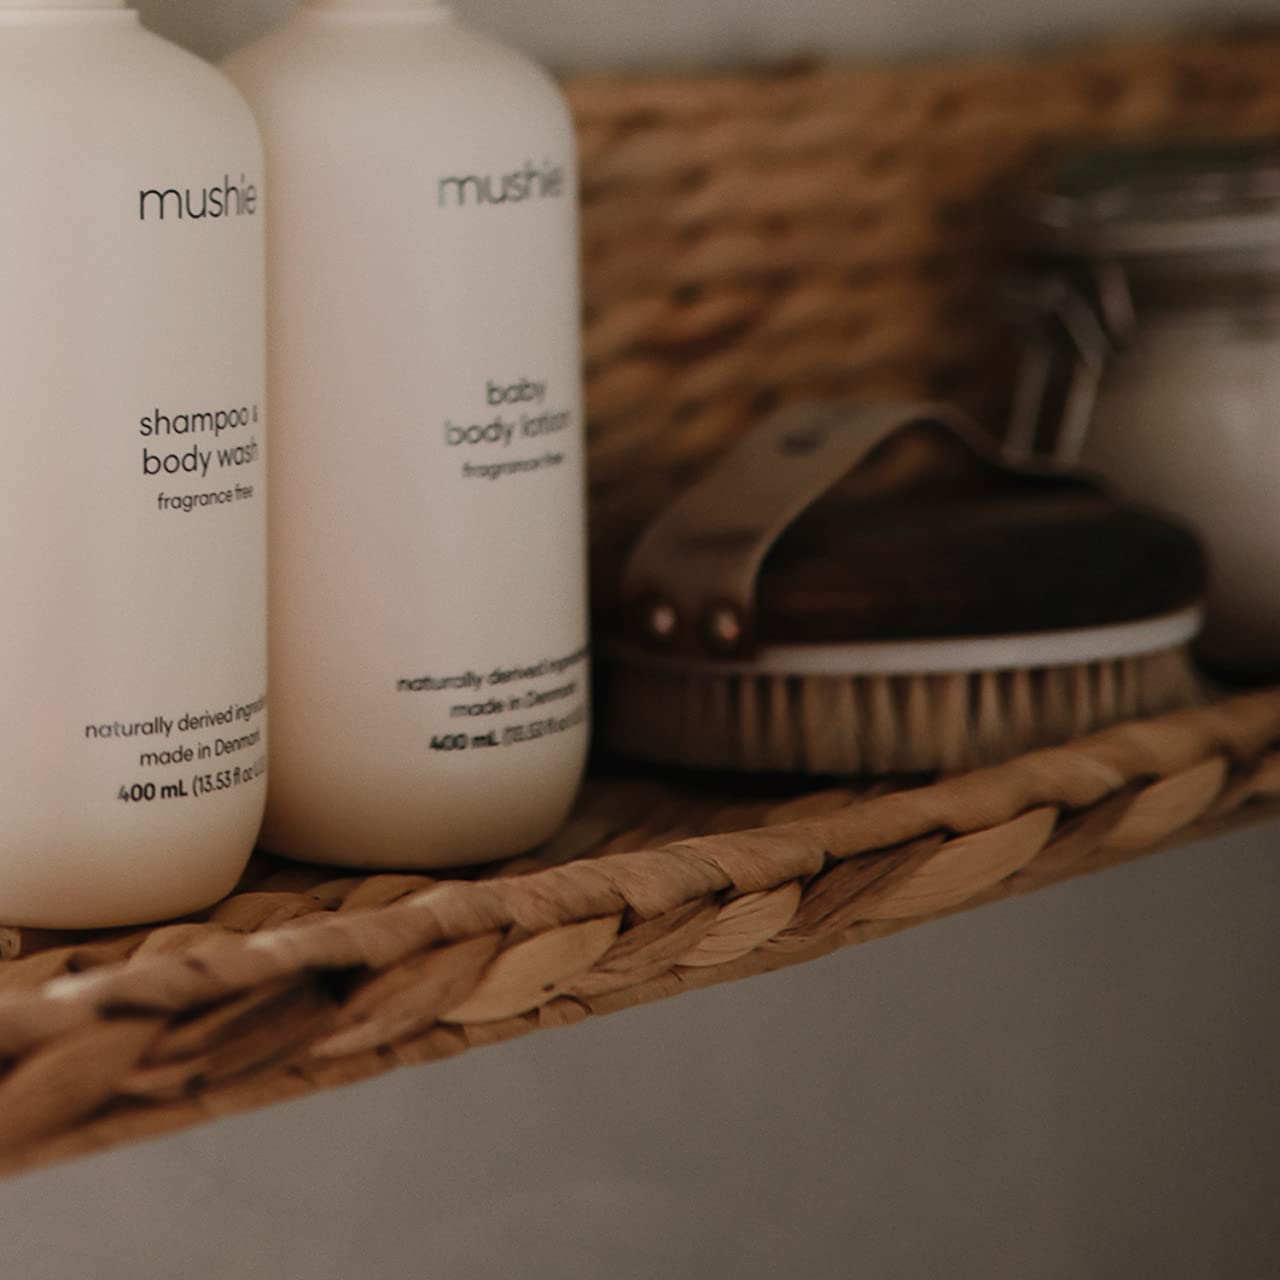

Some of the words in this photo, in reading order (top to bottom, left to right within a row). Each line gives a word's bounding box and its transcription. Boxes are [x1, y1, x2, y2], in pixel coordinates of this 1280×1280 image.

[139, 172, 257, 220] mushie
[139, 406, 249, 437] shampoo
[444, 416, 514, 447] body
[143, 444, 212, 477] body
[158, 490, 232, 512] fragrance
[85, 717, 173, 738] naturally
[178, 705, 233, 733] derived
[140, 745, 193, 766] made
[198, 742, 211, 760] in
[118, 782, 156, 802] 400
[161, 779, 188, 799] mL
